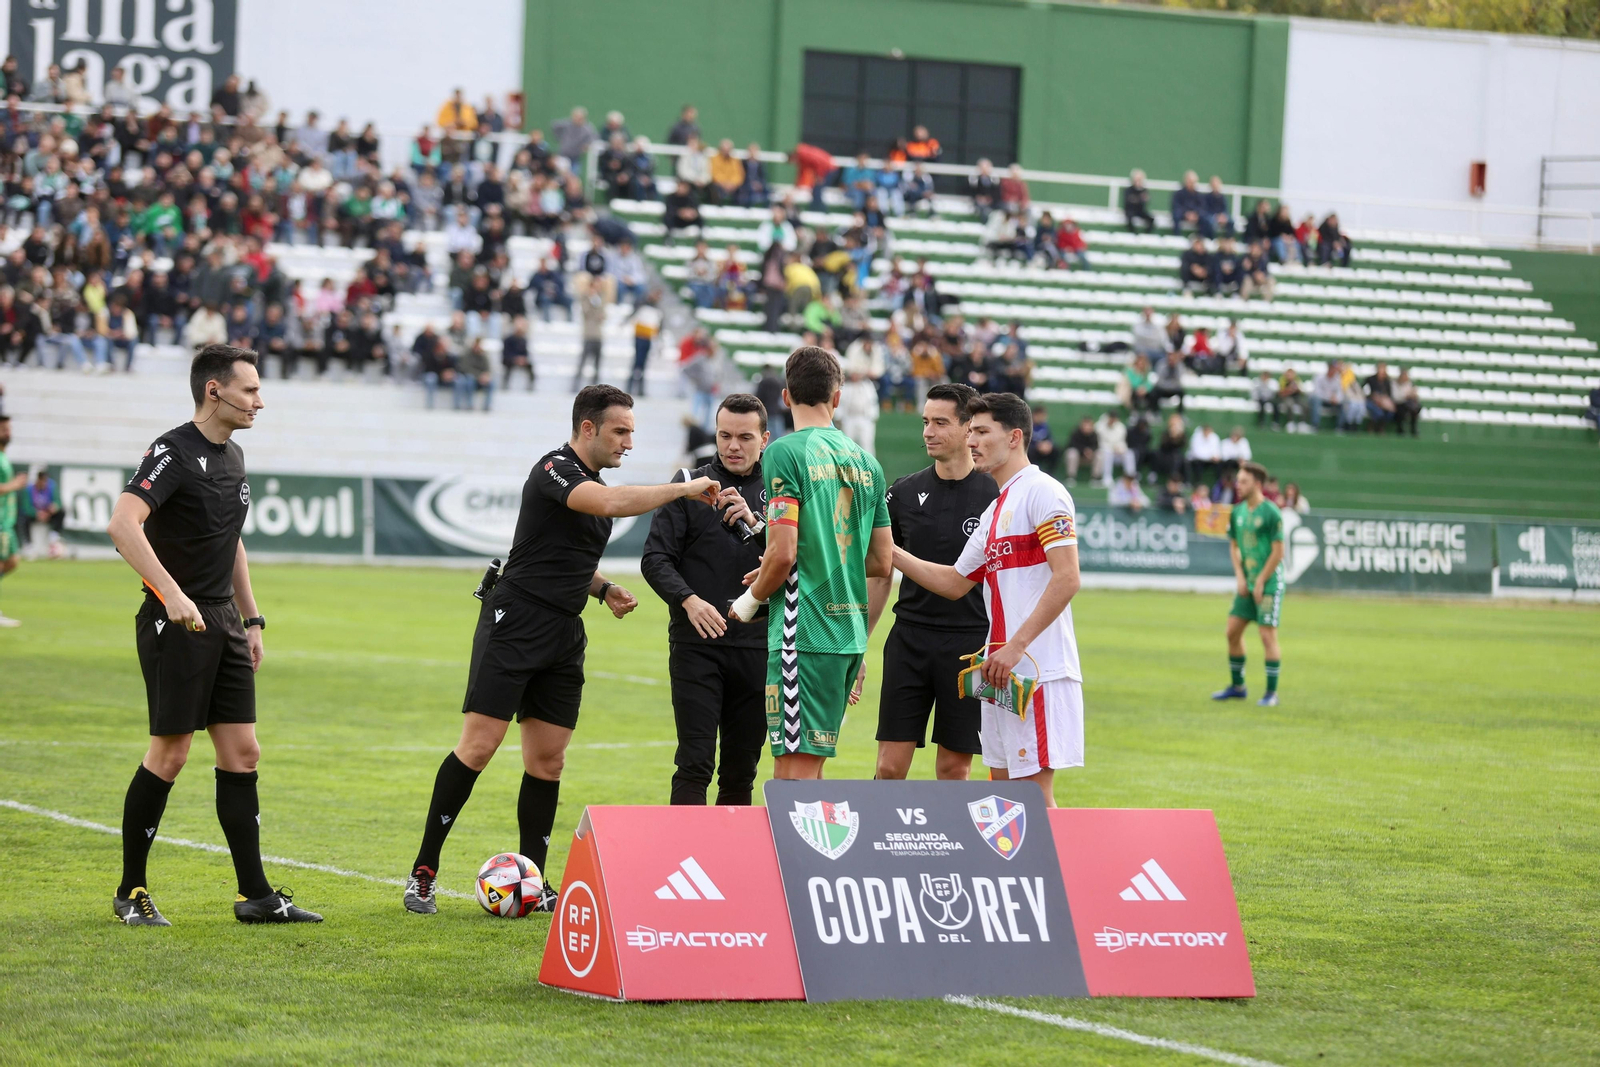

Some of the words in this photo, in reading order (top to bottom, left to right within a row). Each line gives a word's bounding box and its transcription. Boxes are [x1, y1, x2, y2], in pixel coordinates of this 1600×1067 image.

[244, 479, 355, 539] óvil
[1324, 545, 1452, 575] NUTRITION
[896, 808, 928, 825] VS
[996, 807, 1021, 827] HUESCA
[791, 815, 830, 856] ANTEQUERA
[873, 842, 964, 850] ELIMINATORIA
[885, 833, 948, 842] SEGUNDA
[568, 904, 591, 926] RF
[808, 876, 926, 945] COPA
[971, 876, 1051, 943] REY
[568, 931, 591, 954] EF
[938, 933, 971, 943] DEL
